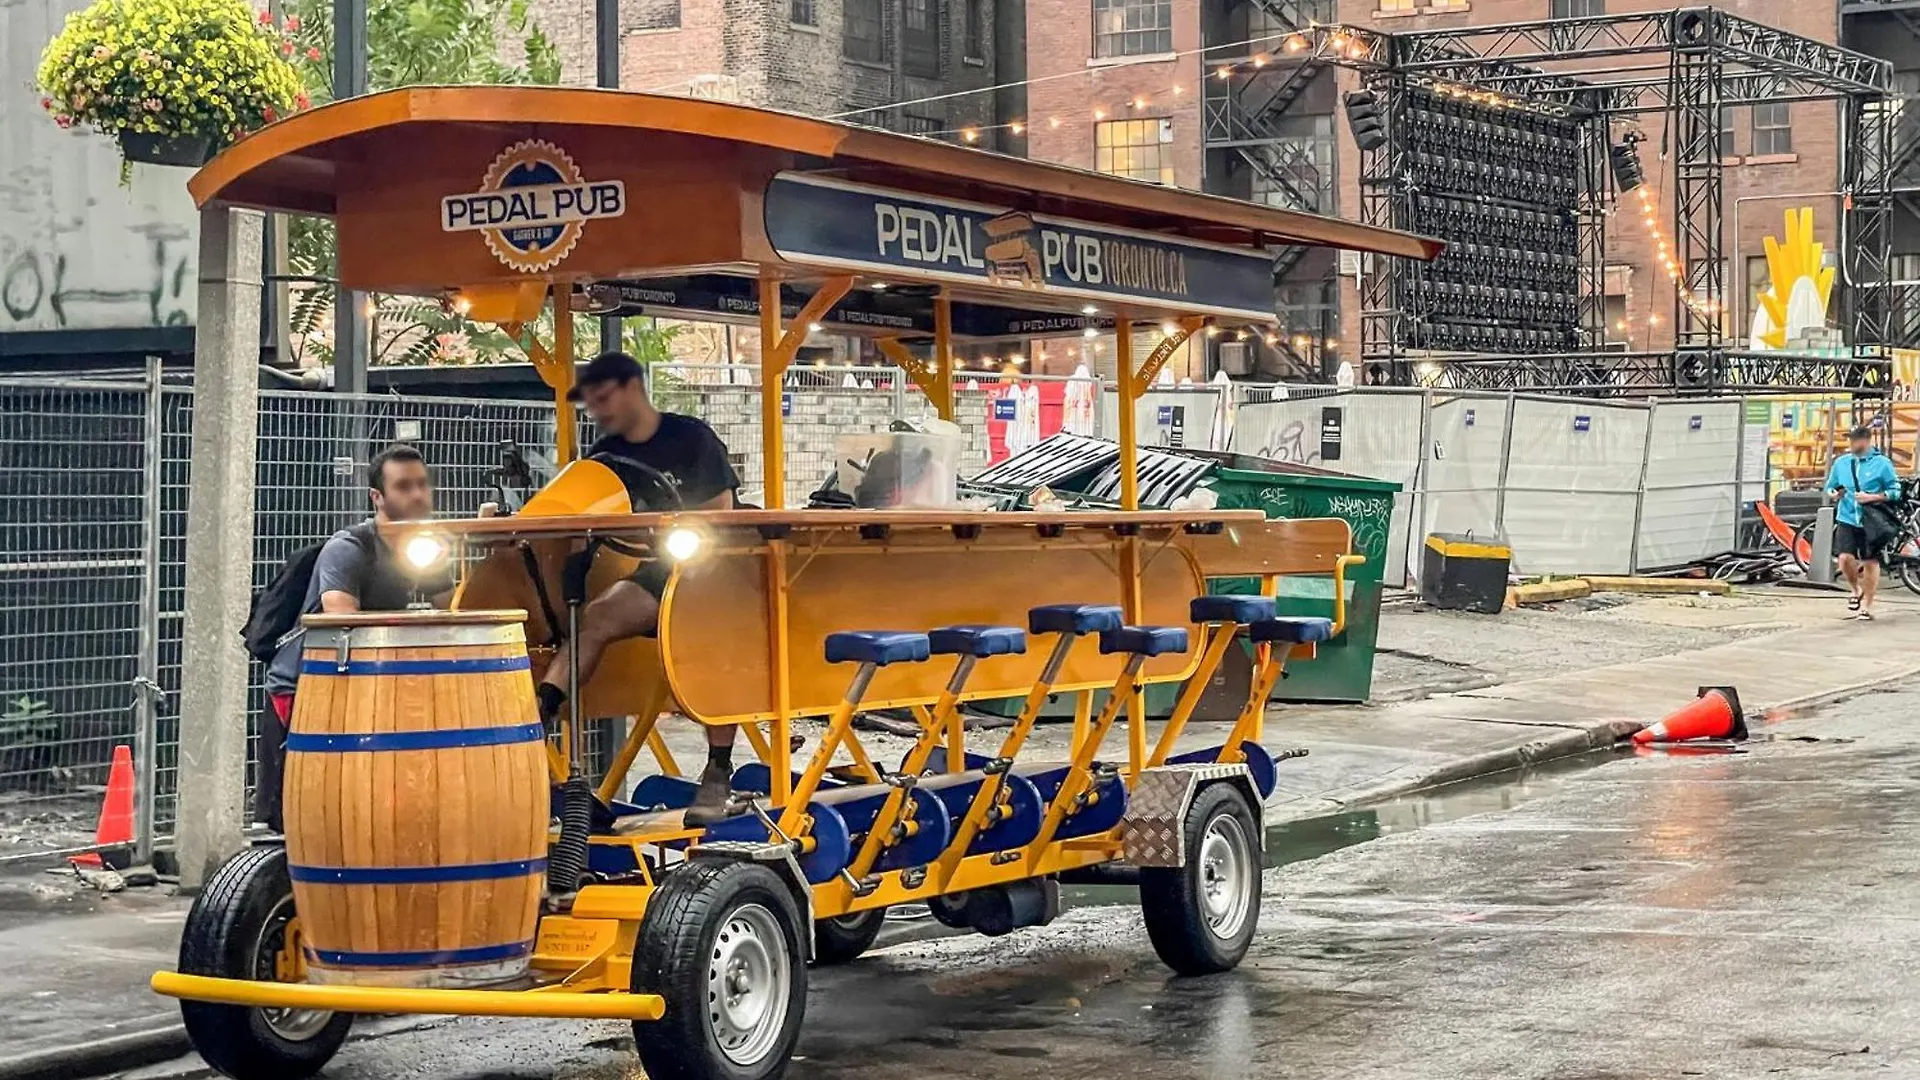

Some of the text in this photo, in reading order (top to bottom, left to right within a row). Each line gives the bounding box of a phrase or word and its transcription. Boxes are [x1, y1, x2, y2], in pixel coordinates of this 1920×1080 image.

[445, 184, 622, 228] PEDAL PUB
[874, 203, 985, 269] PEDAL
